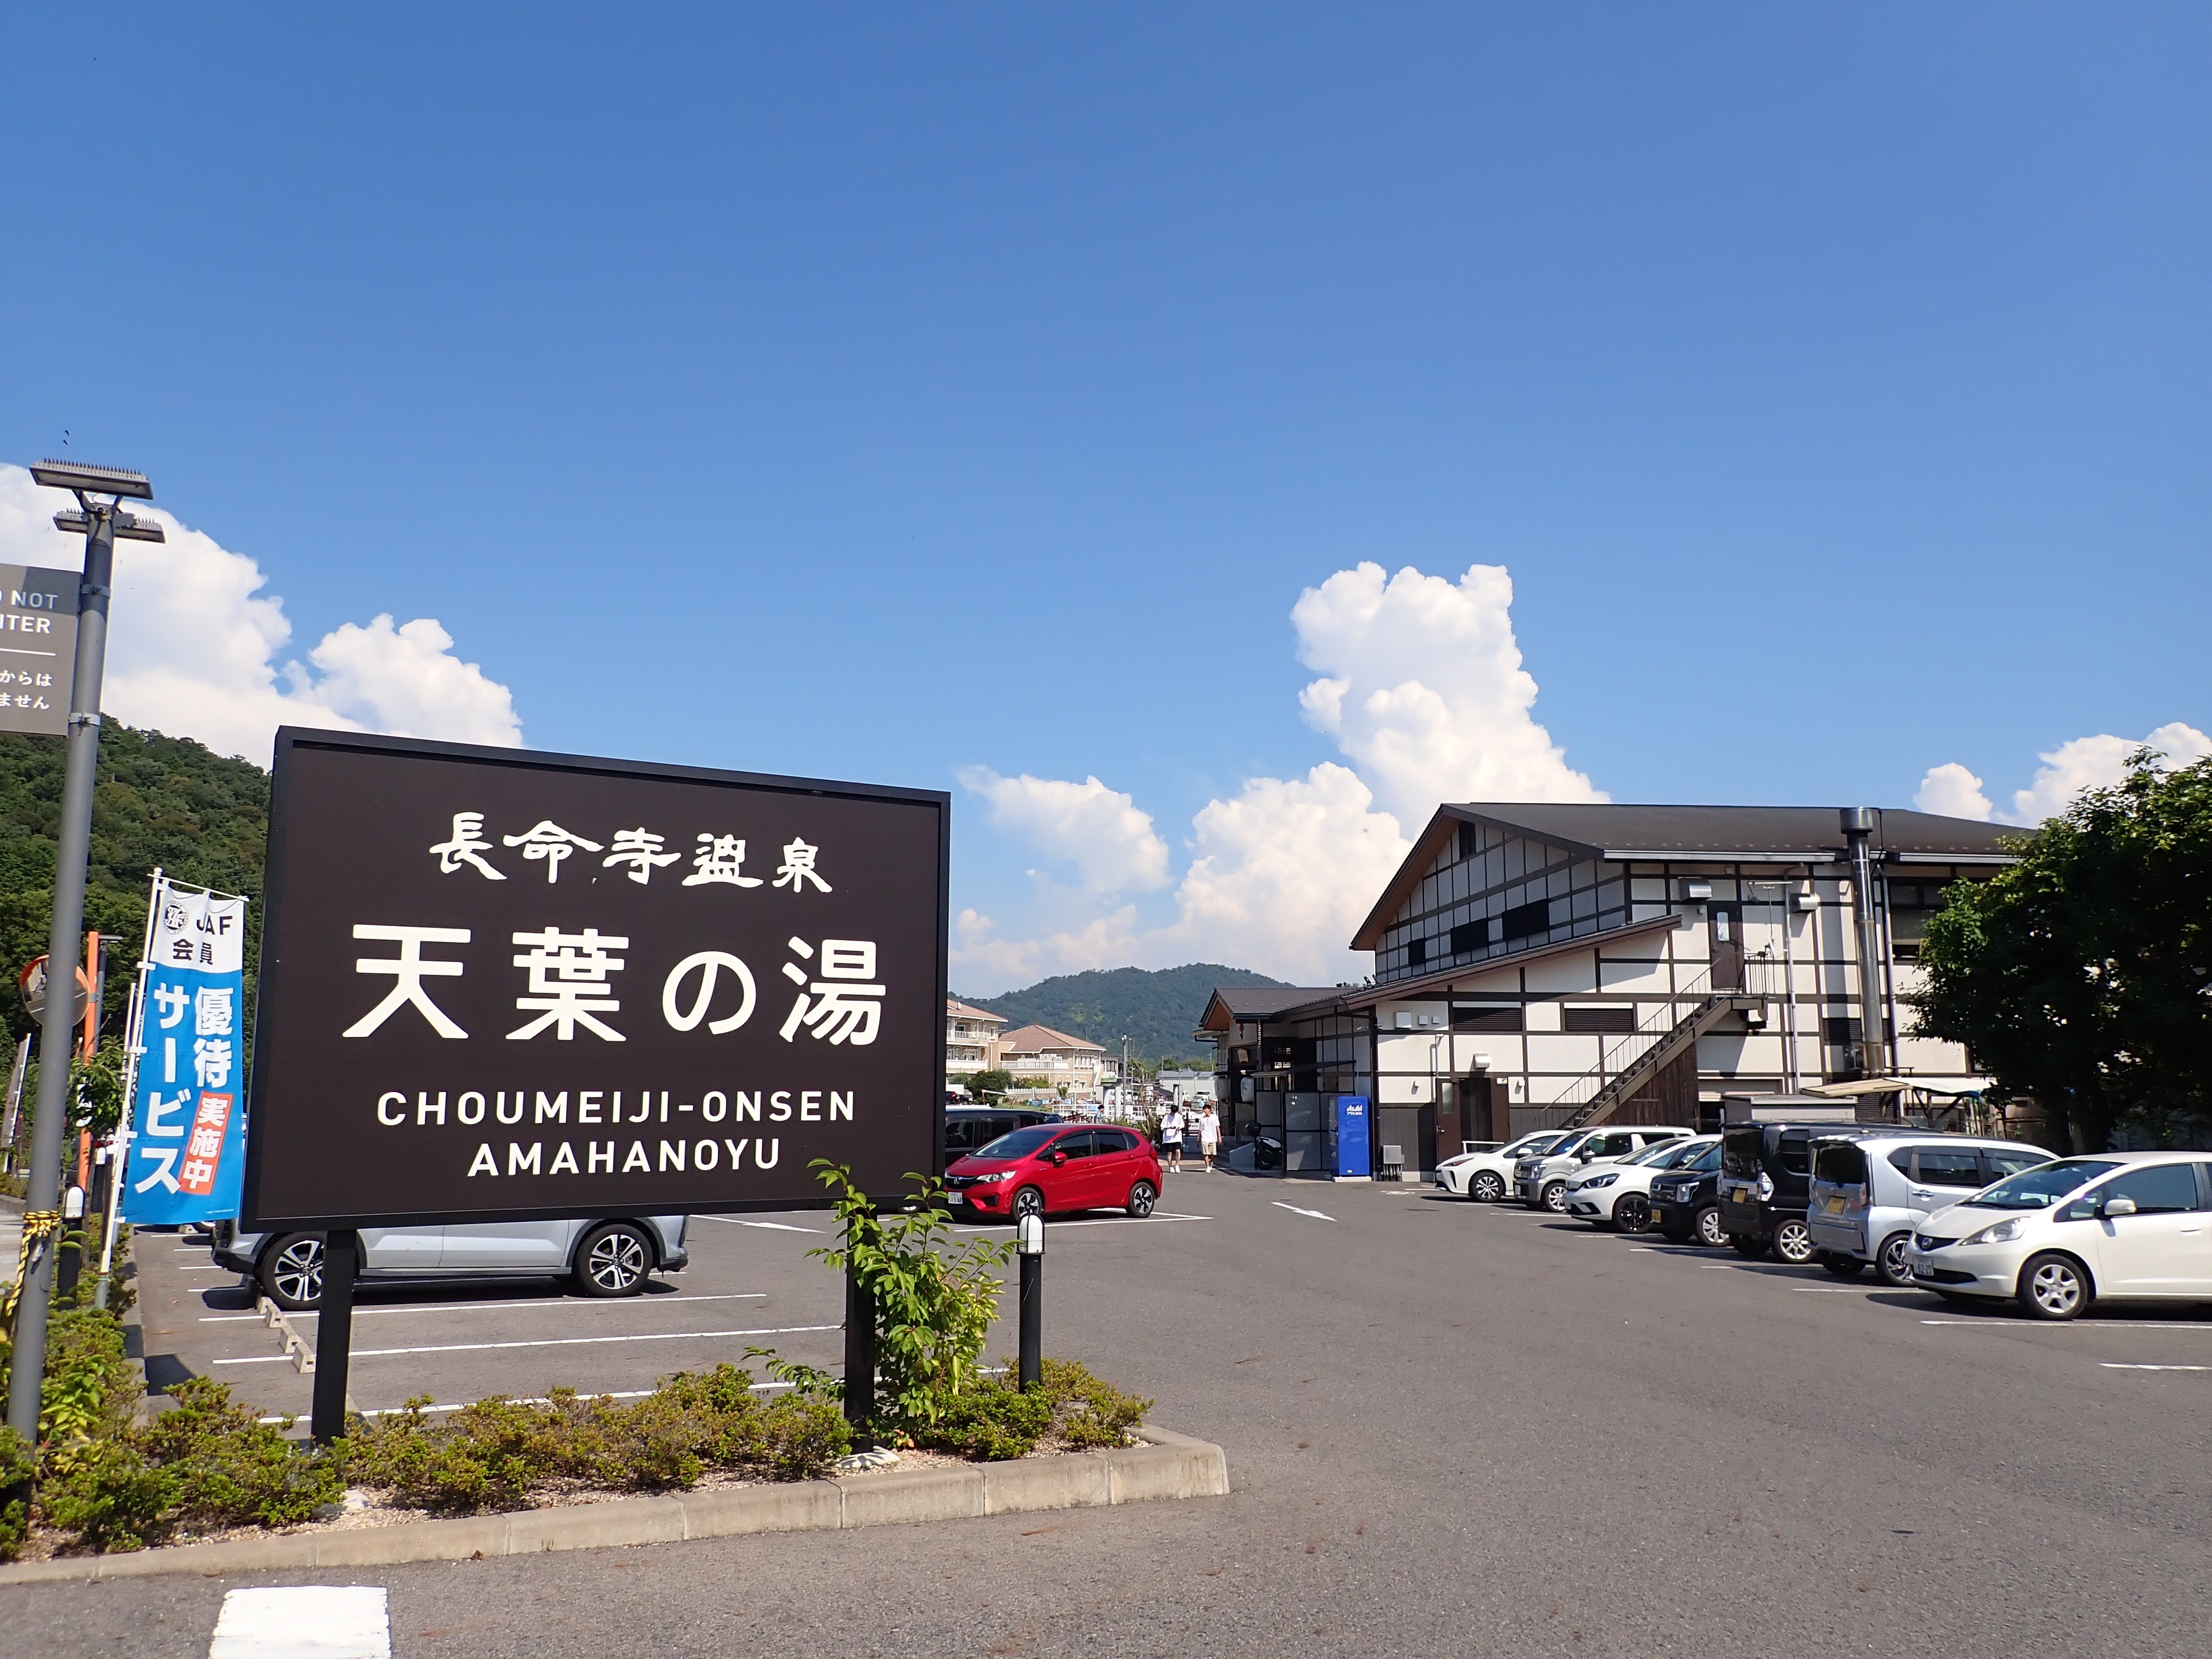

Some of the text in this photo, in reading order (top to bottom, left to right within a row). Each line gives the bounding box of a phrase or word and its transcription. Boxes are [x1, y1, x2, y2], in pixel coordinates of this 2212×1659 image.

[12, 590, 59, 609] NOT
[0, 670, 53, 686] からは
[196, 915, 233, 935] JAF
[173, 938, 214, 966] 会員
[342, 924, 886, 1046] 天葉の湯
[194, 986, 234, 1088] 優待
[134, 982, 192, 1194] サービス
[377, 1091, 854, 1126] CHOUMEIJI-ONSEN
[182, 1096, 228, 1190] 実施中
[467, 1138, 780, 1177] AMAHANOYU
